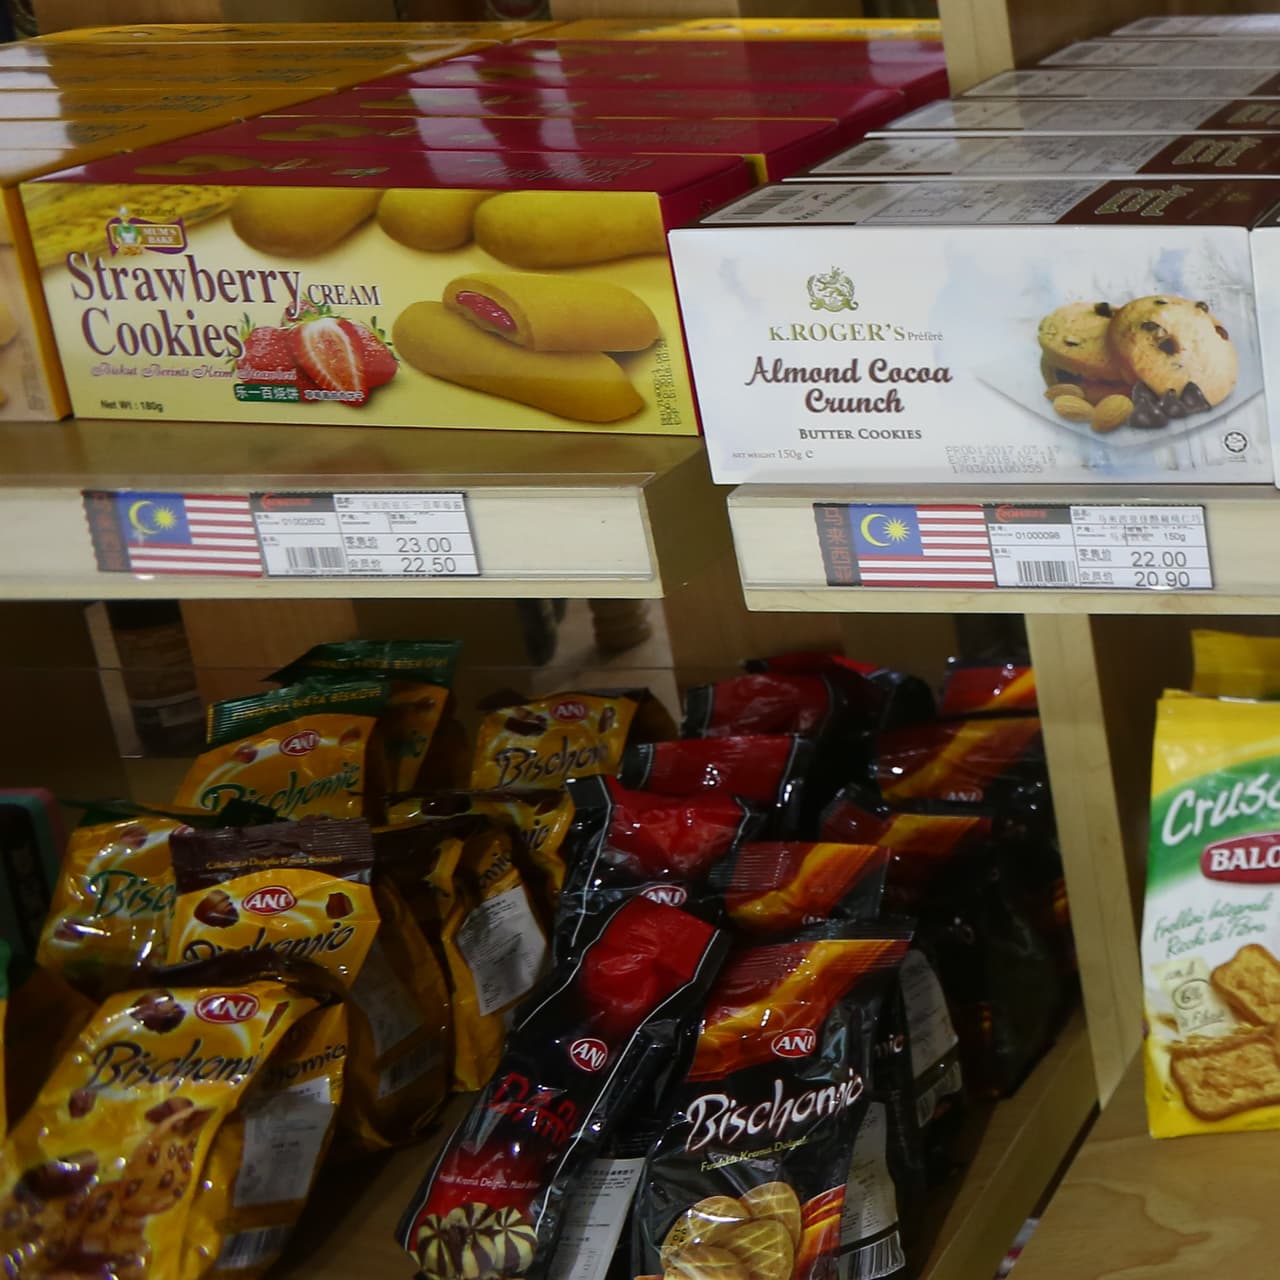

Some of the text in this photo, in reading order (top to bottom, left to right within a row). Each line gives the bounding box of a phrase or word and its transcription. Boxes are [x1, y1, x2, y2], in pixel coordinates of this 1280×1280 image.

[66, 251, 382, 317] Strawberry CREAM
[81, 307, 245, 359] Cookies
[769, 322, 905, 342] K.ROGER'S
[744, 356, 953, 386] Almond Cocoa
[805, 388, 905, 414] Crunch
[396, 537, 452, 553] 23.00
[401, 556, 456, 573] 22.50
[1131, 551, 1187, 568] 22.00
[1134, 571, 1191, 588] 20.90
[244, 892, 290, 910] ANI
[776, 1035, 815, 1052] ANI
[574, 1043, 606, 1068] ANI
